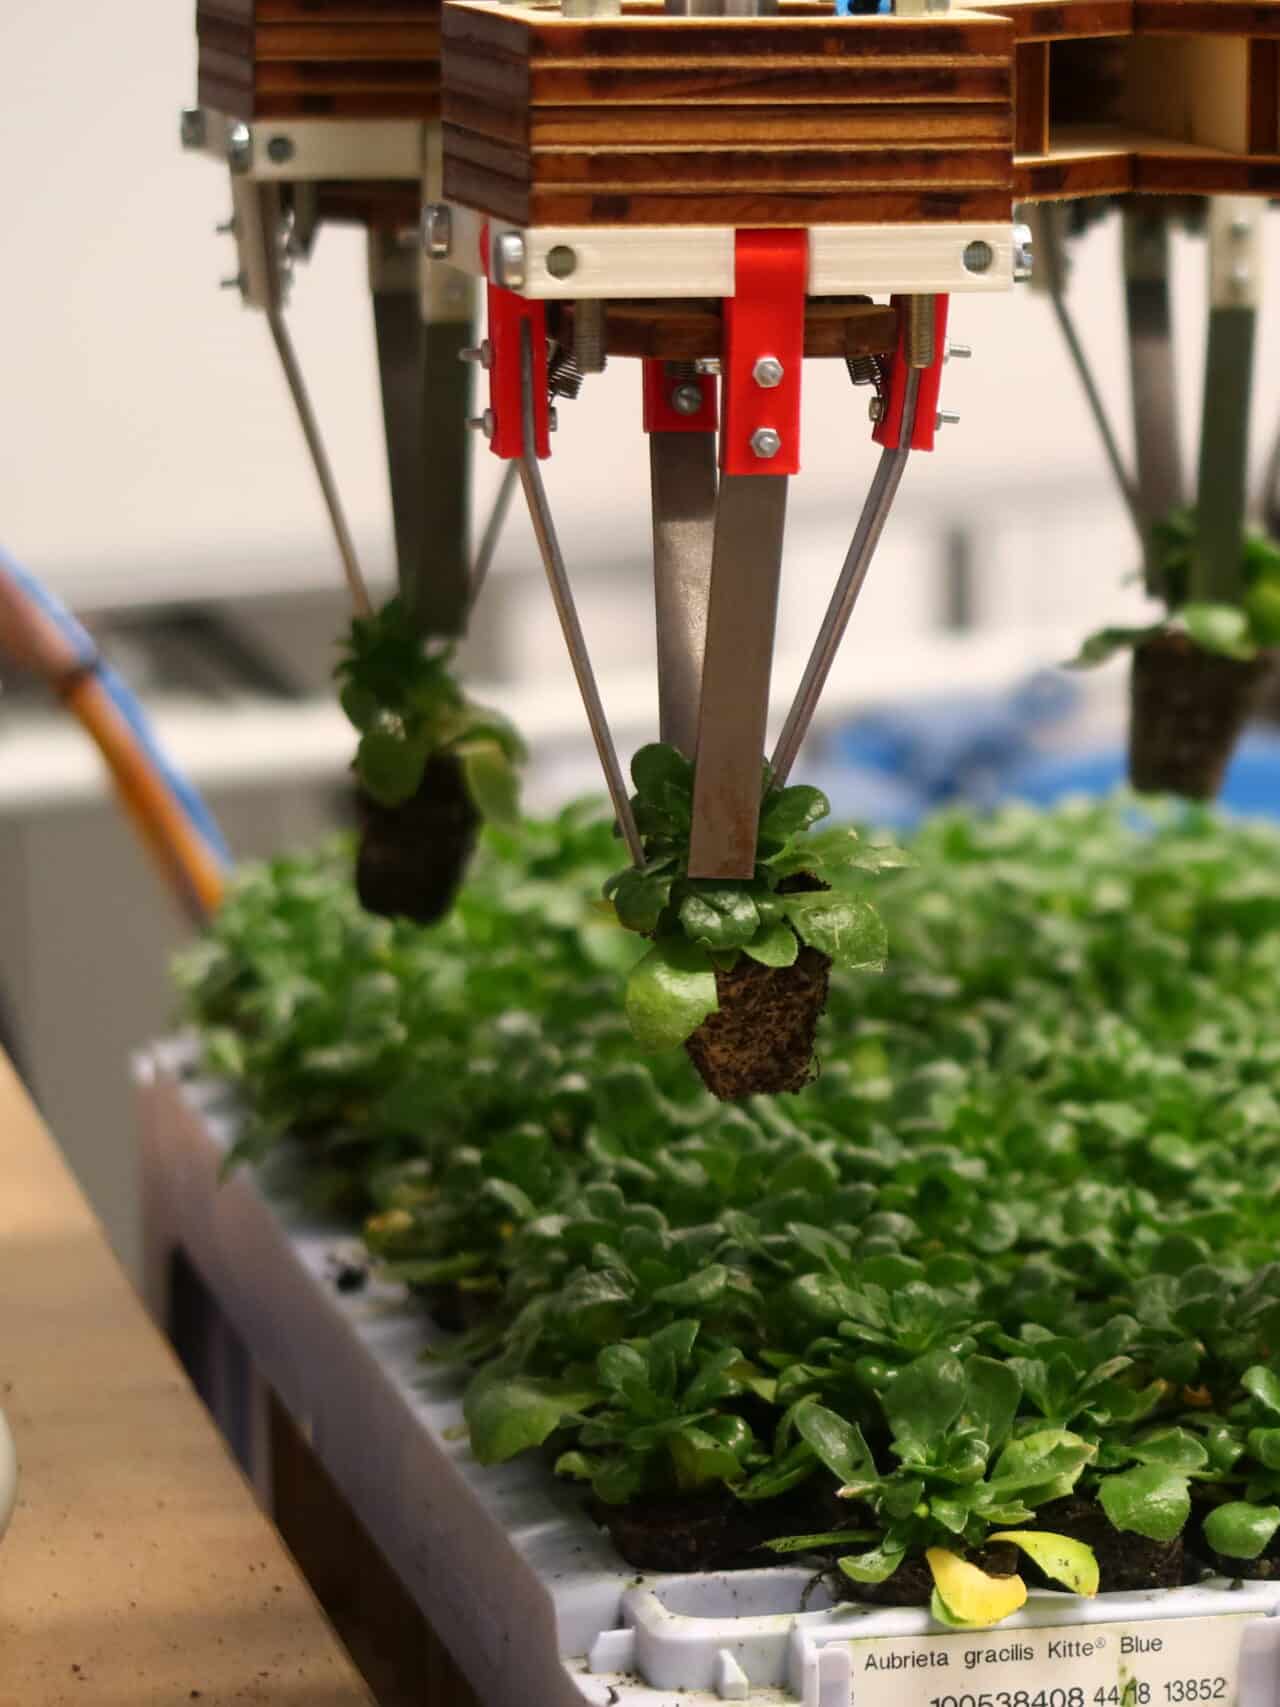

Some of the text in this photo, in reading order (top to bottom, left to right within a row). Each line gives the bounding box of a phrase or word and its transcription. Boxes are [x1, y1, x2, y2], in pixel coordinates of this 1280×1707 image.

[864, 1652, 950, 1671] Aubrieta
[964, 1647, 1035, 1669] gracilis
[1121, 1636, 1164, 1654] Blue
[1163, 1677, 1227, 1702] 13852
